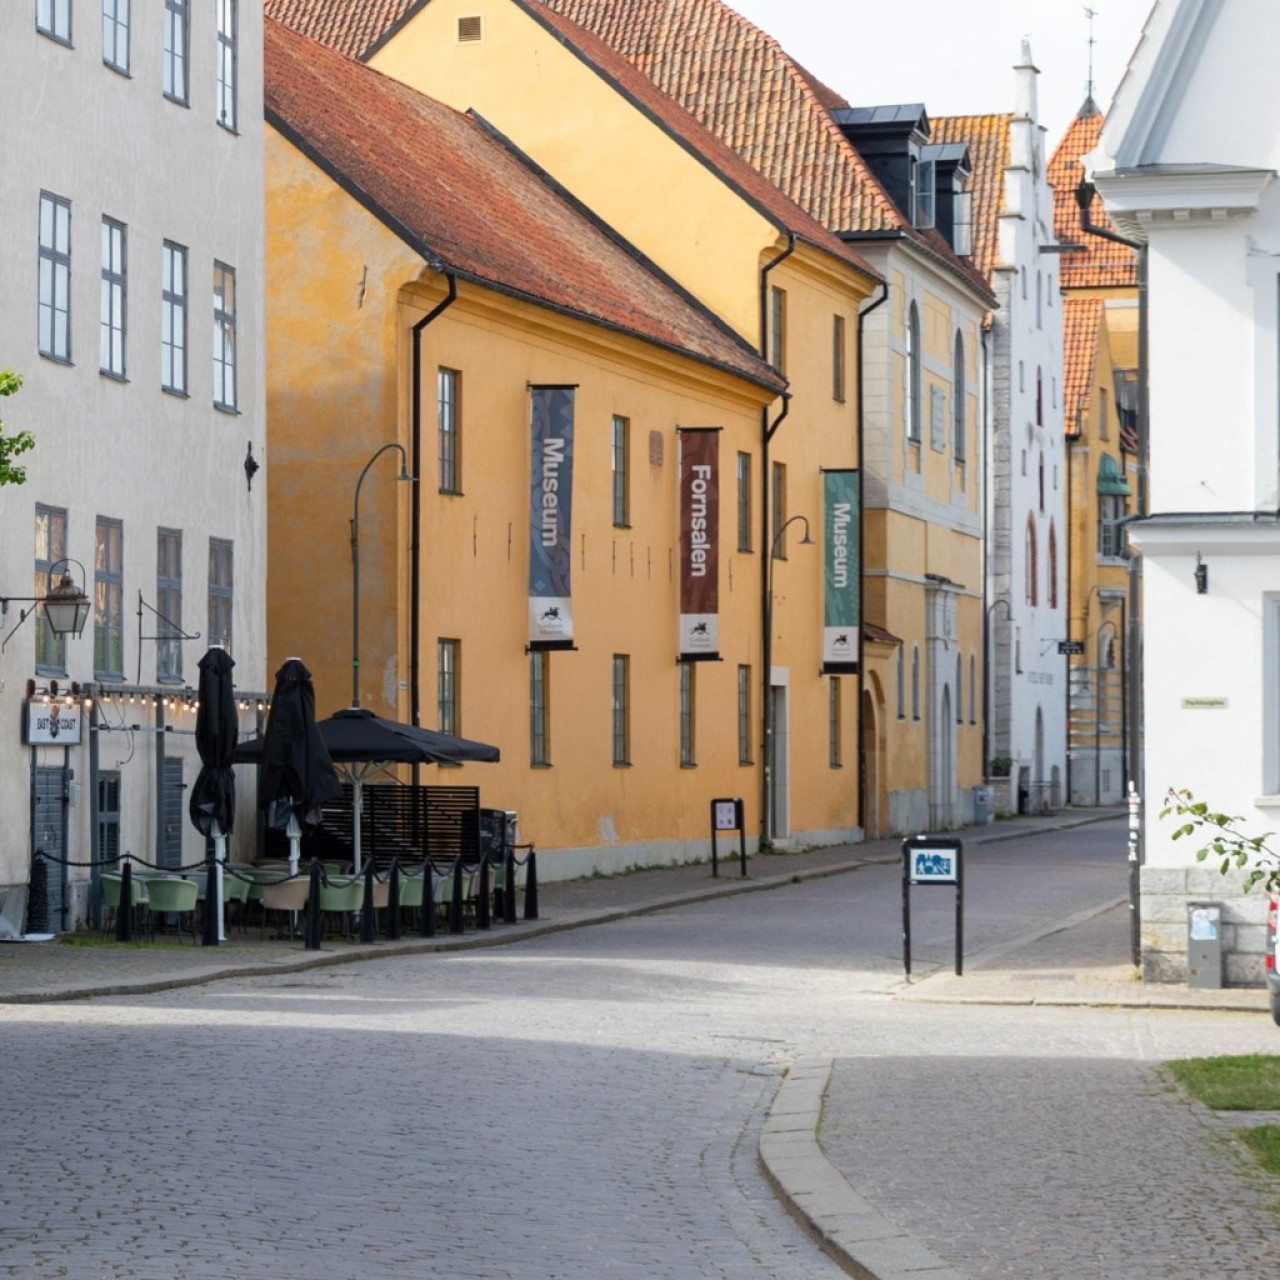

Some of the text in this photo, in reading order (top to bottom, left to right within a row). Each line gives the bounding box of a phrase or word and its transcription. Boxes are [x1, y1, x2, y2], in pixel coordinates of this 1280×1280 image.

[542, 438, 565, 547] Museum
[691, 464, 711, 577] Fornsalen
[833, 503, 851, 588] Museum
[37, 718, 76, 730] EAST COAST
